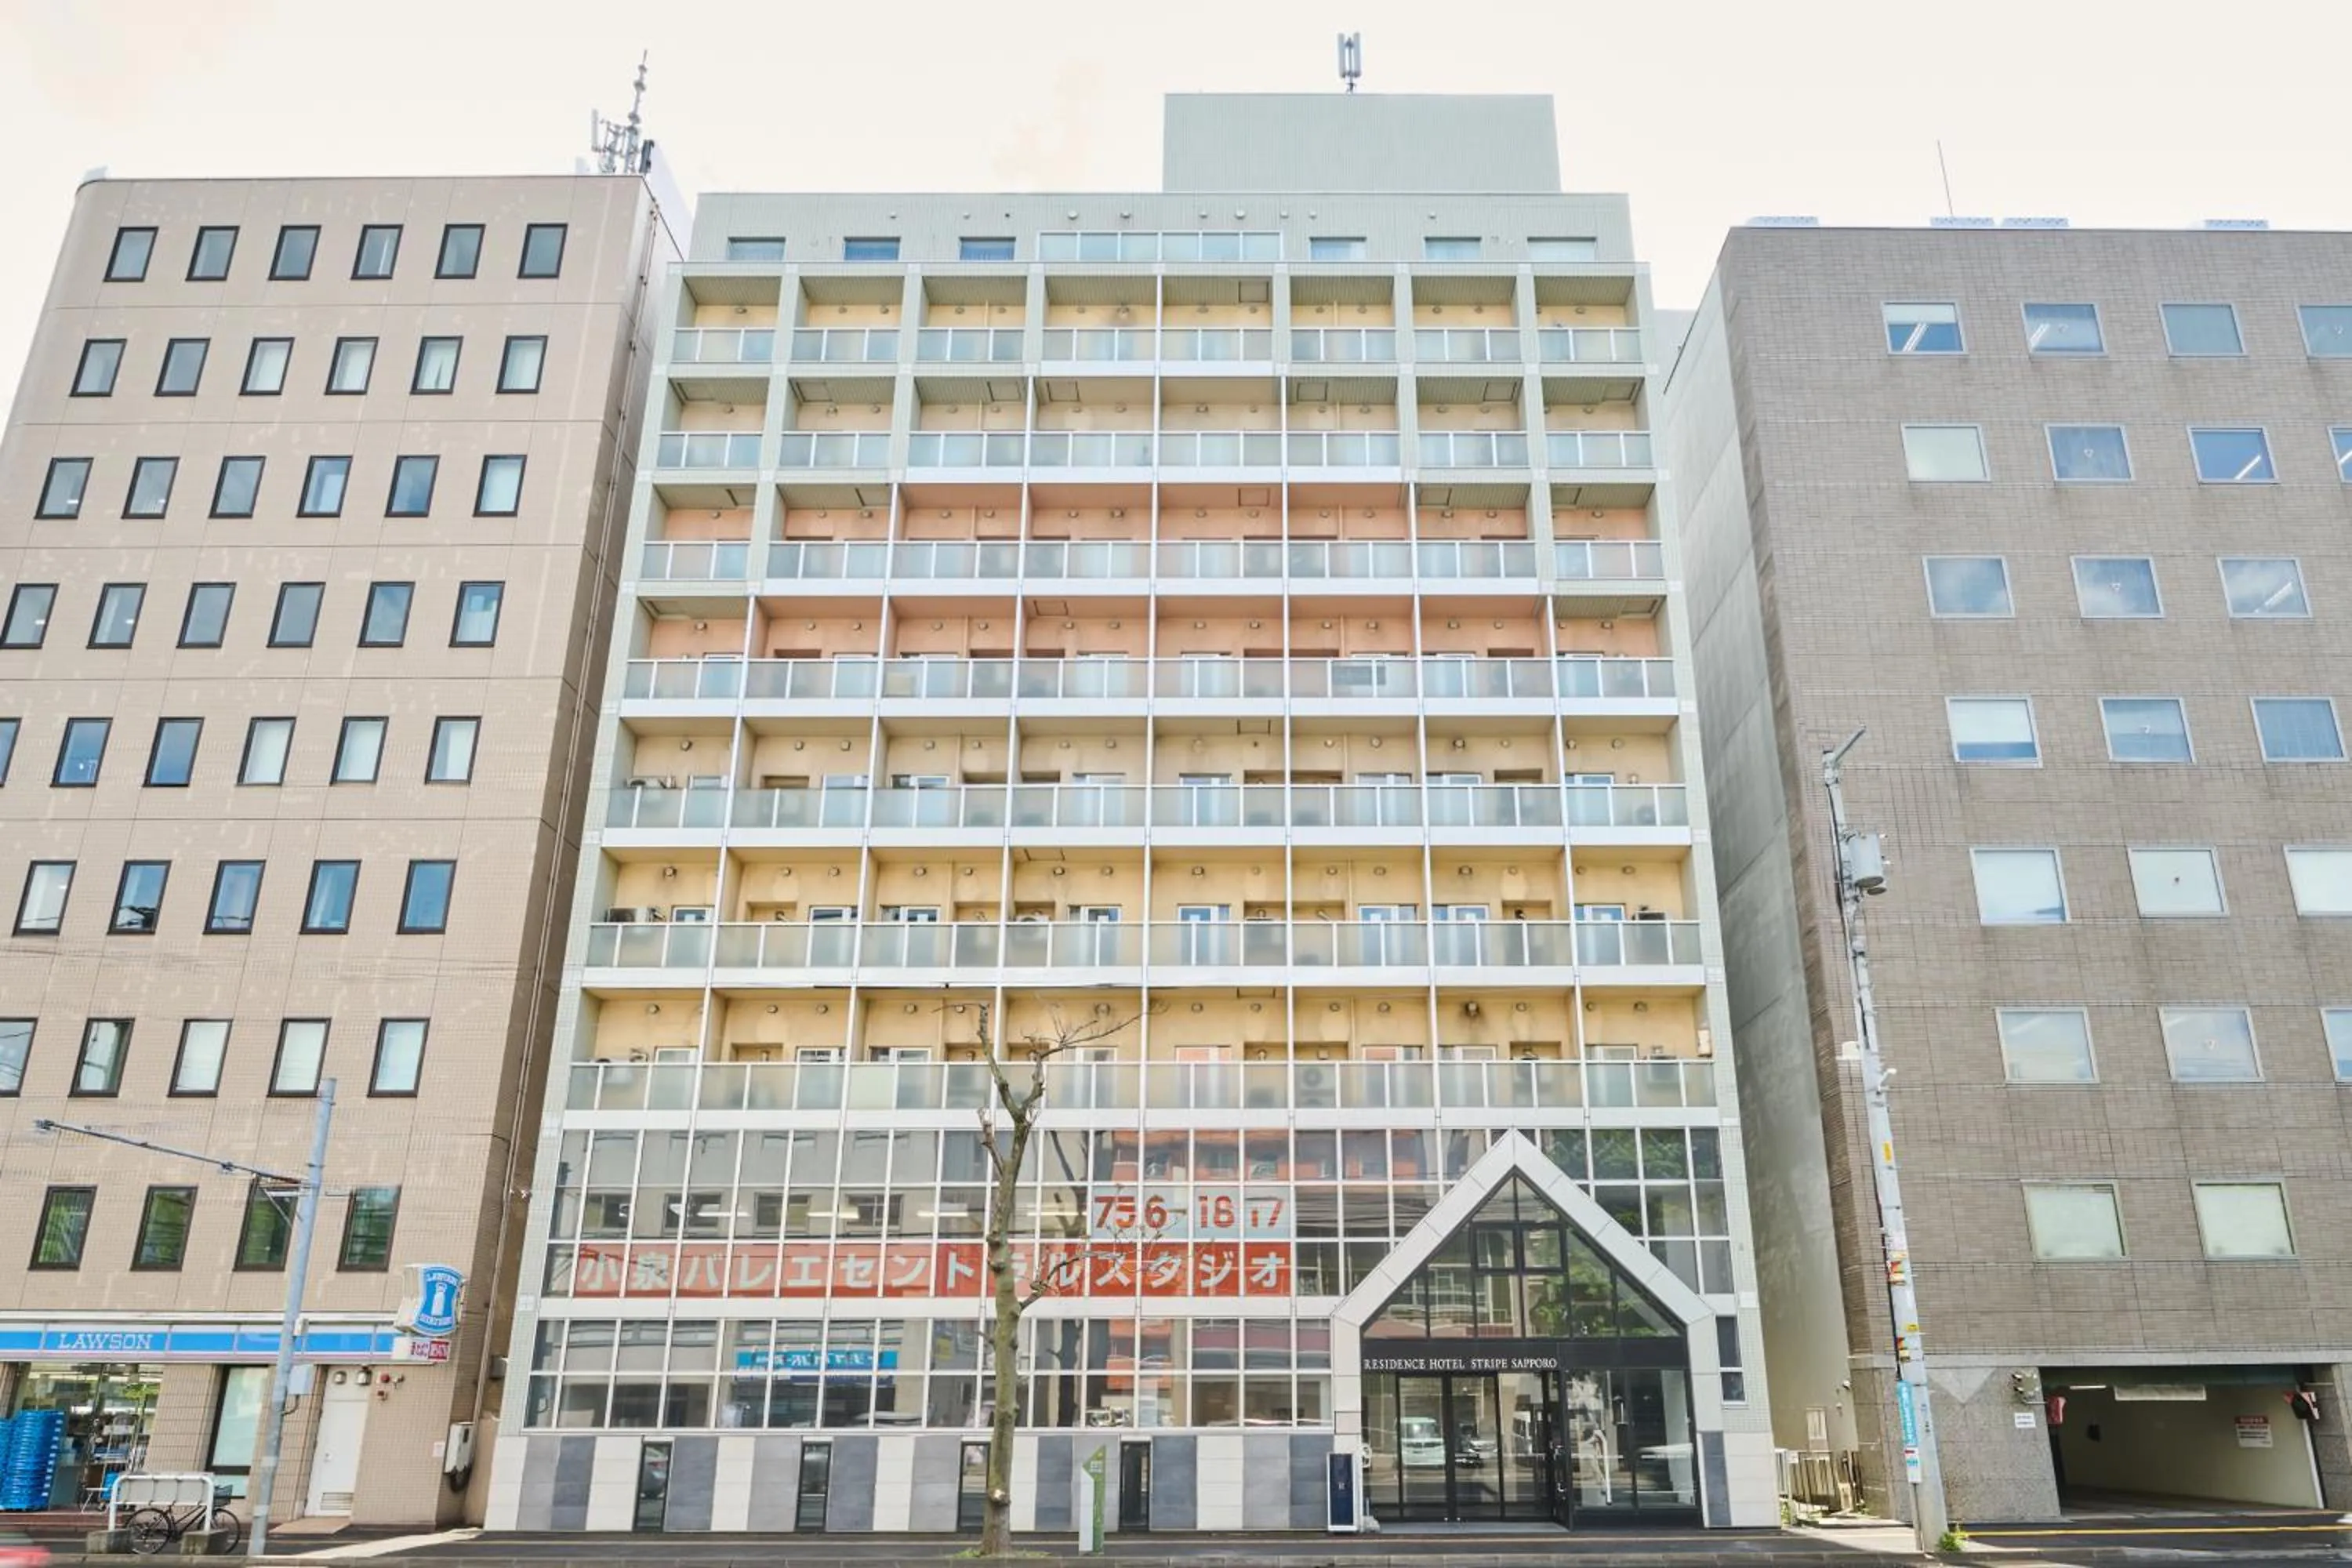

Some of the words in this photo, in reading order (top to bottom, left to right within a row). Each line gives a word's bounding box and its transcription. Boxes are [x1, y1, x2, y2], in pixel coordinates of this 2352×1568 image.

[57, 1333, 154, 1349] LAWSON
[1363, 1359, 1426, 1370] RESIDENCE
[1429, 1359, 1465, 1370] HOTEL
[1471, 1358, 1508, 1369] STRIPE
[1511, 1357, 1558, 1368] SAPPORO
